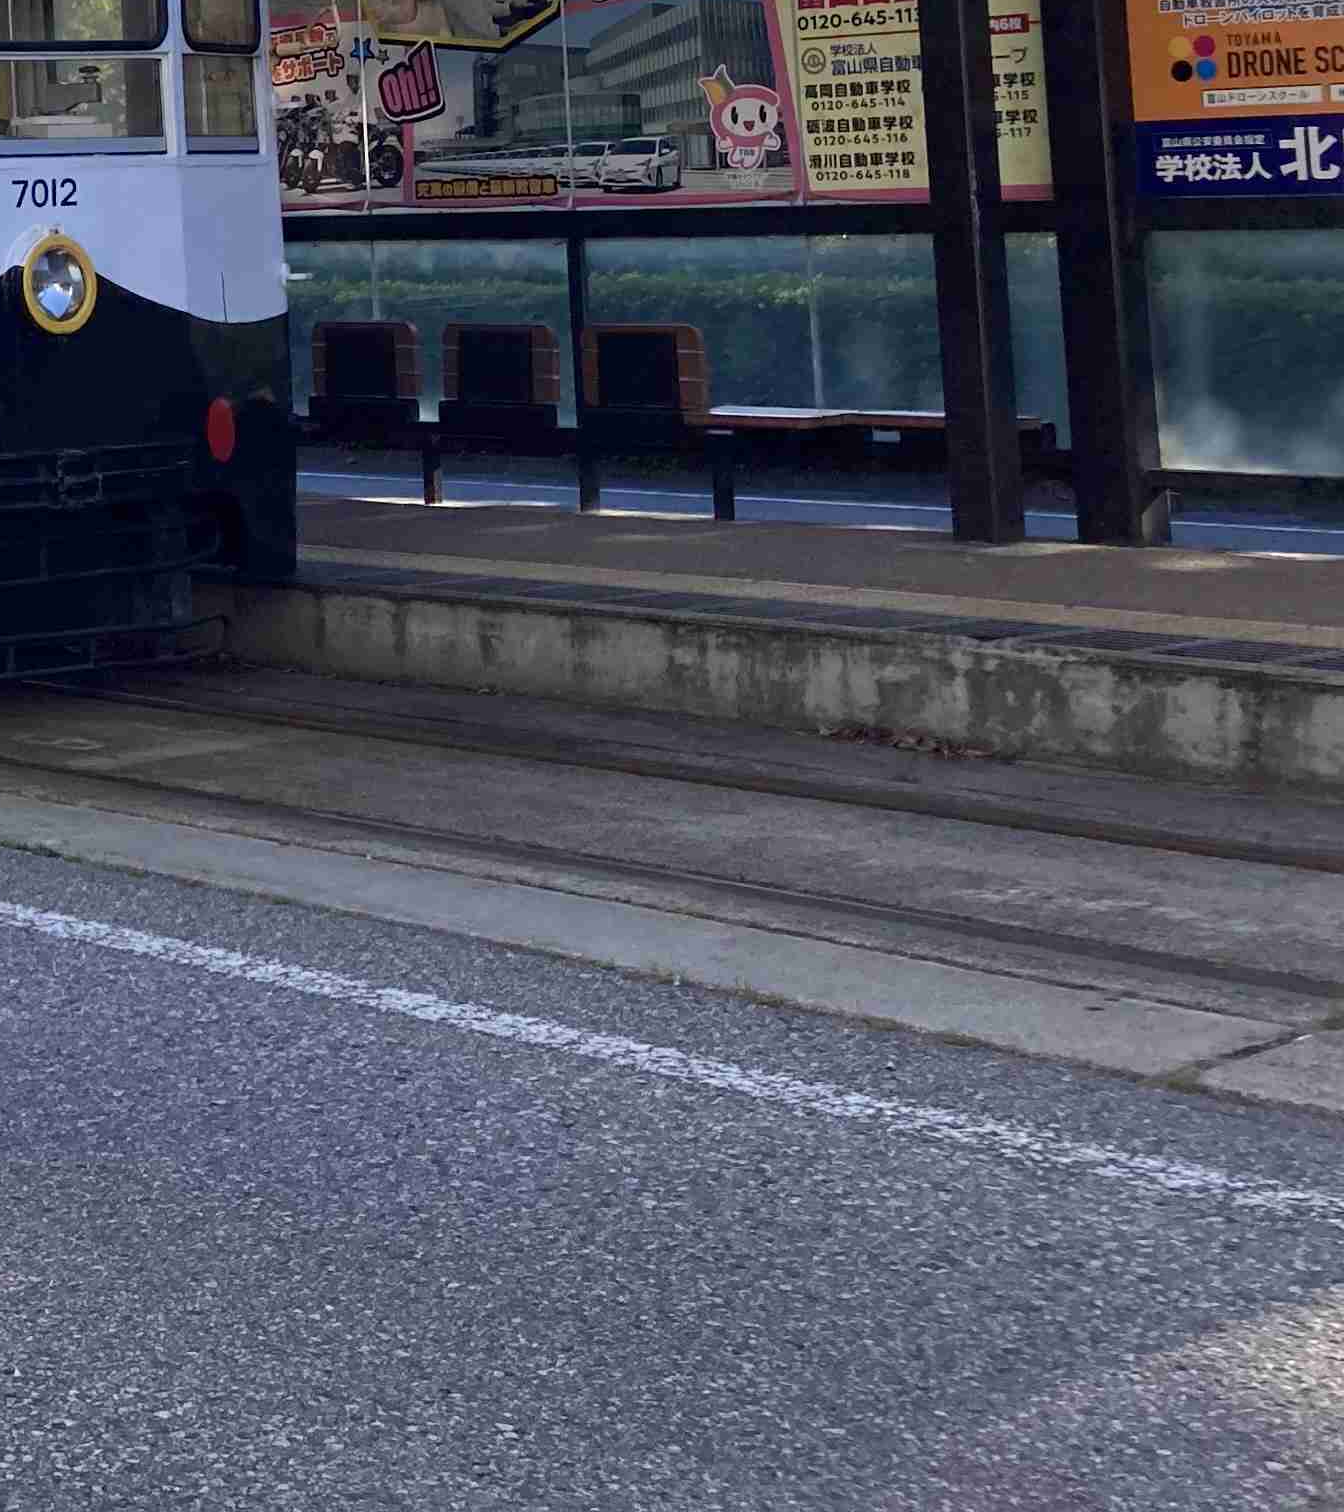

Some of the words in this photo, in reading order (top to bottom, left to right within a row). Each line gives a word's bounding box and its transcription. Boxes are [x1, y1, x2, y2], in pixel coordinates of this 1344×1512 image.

[1226, 31, 1282, 47] TOYAMA
[831, 41, 877, 57] 学校法人
[1227, 47, 1306, 79] DRONE
[811, 96, 907, 111] 0120-645-114
[814, 132, 909, 147] 0120-645-116
[1279, 126, 1341, 181] 北
[816, 168, 911, 182] 0120-645-118
[1155, 151, 1273, 183] 学校法人
[11, 178, 78, 208] 7012
